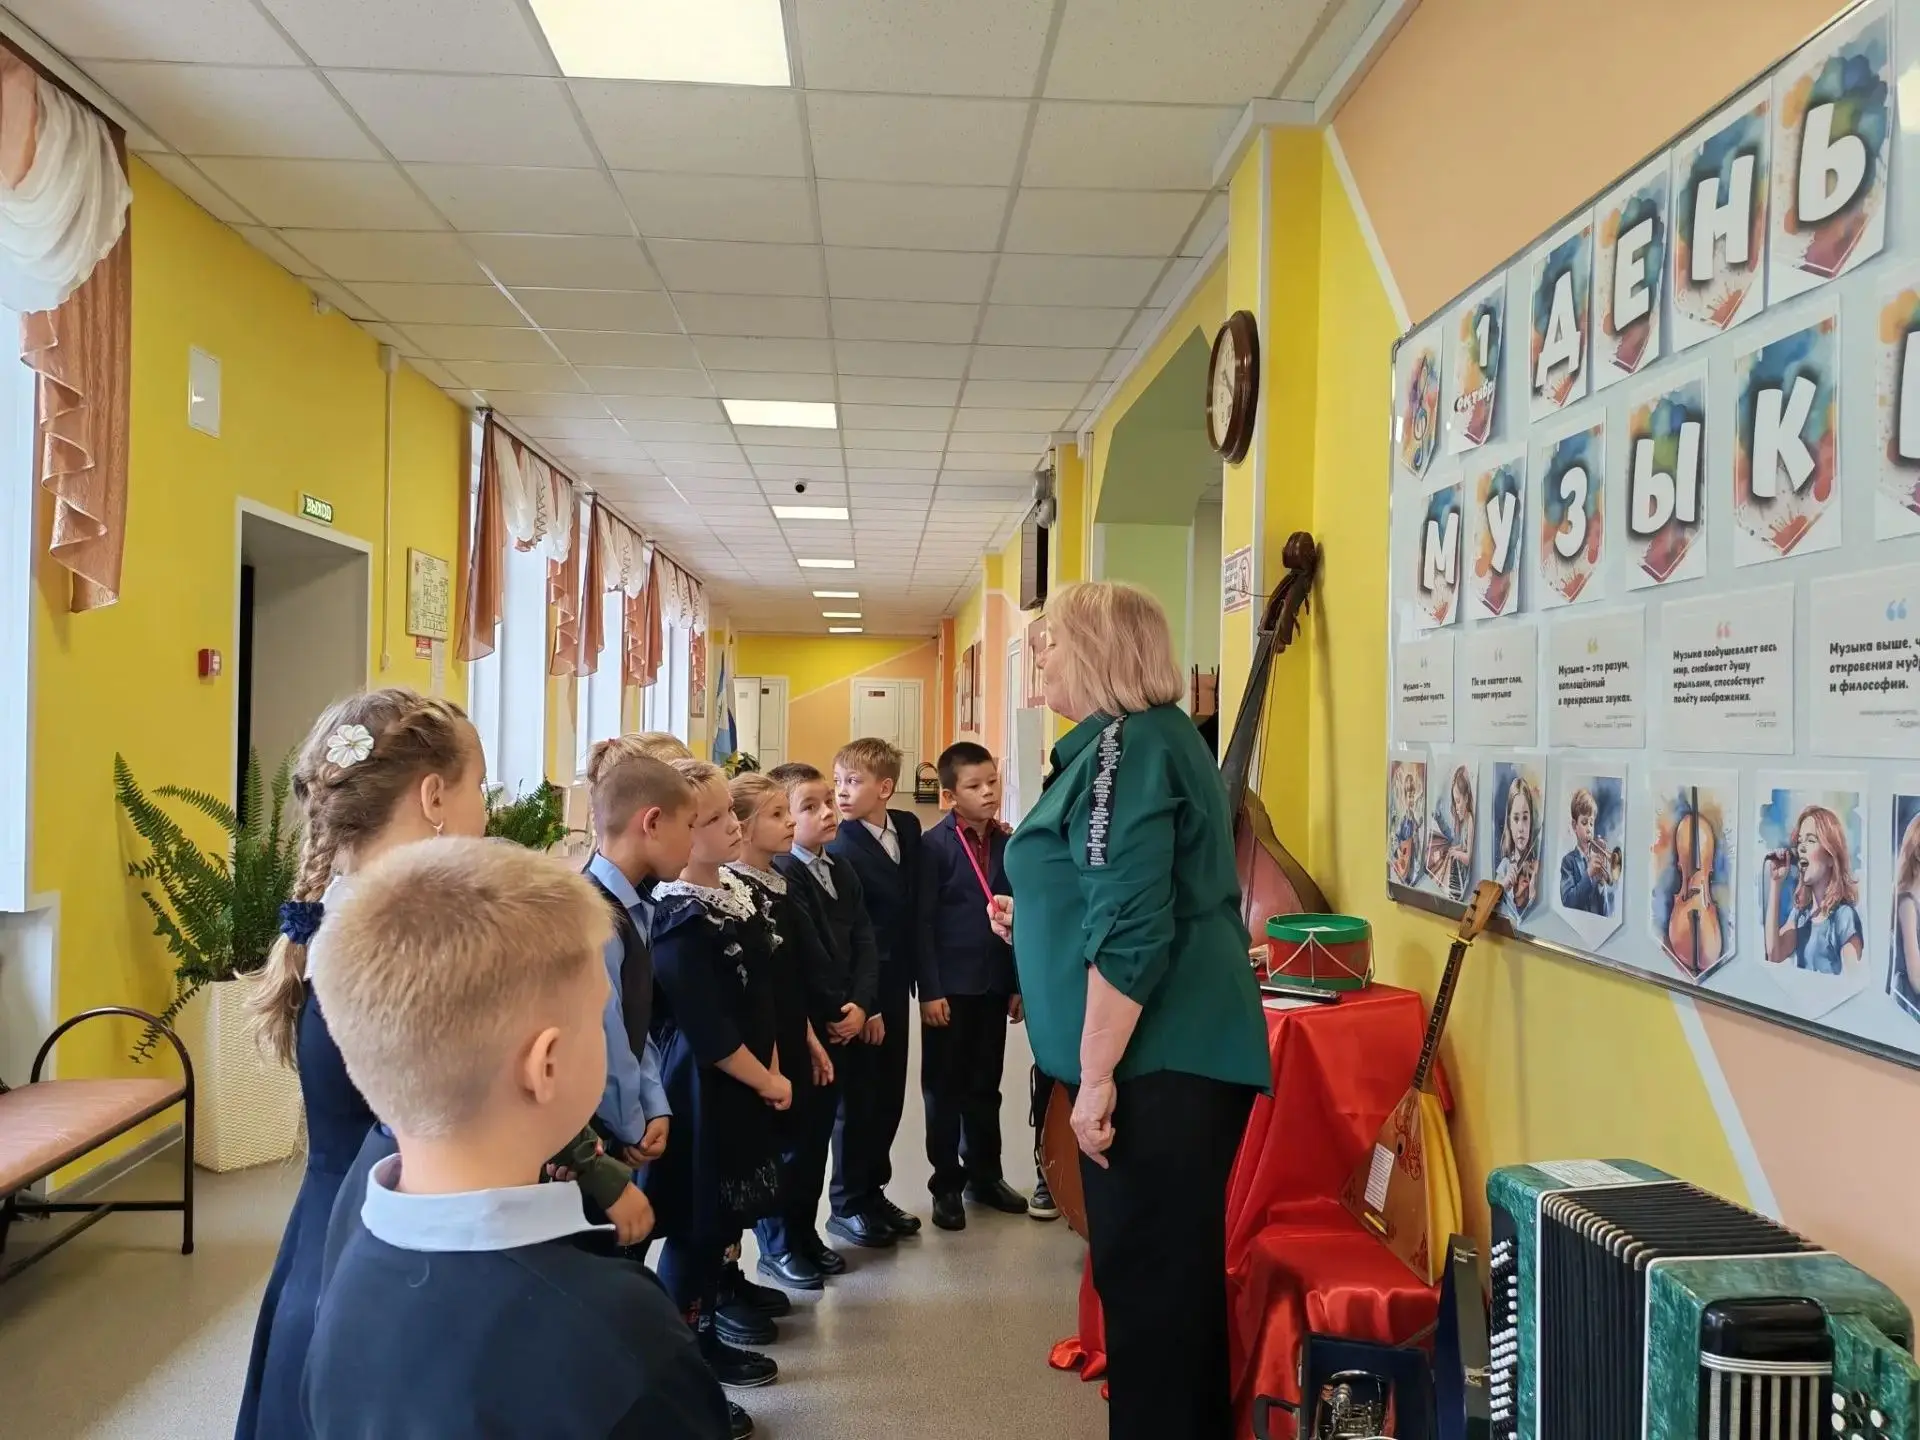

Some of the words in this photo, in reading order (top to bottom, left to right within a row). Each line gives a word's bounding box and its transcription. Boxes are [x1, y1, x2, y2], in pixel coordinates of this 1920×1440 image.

[1536, 102, 1867, 388] ДЕНЬ
[1476, 314, 1491, 367] 1
[306, 497, 332, 521] ВЫХОД
[1673, 650, 1702, 662] Музыка
[1703, 645, 1758, 659] воодушевляет
[1759, 643, 1777, 653] весь
[1830, 642, 1873, 657] Музыка
[1558, 664, 1584, 677] Музыка
[1592, 663, 1603, 672] это
[1691, 662, 1727, 673] снабжает
[1729, 659, 1750, 673] душу
[1830, 660, 1893, 676] откровения
[1558, 676, 1605, 690] воплощённый
[1673, 679, 1712, 692] крыльями,
[1714, 676, 1765, 688] способствует
[1830, 683, 1836, 692] и
[1839, 676, 1909, 696] философии.
[1563, 696, 1604, 708] прекрасных
[1605, 694, 1632, 706] звуках.
[1673, 692, 1698, 705] полёту
[1699, 692, 1751, 705] воображения.
